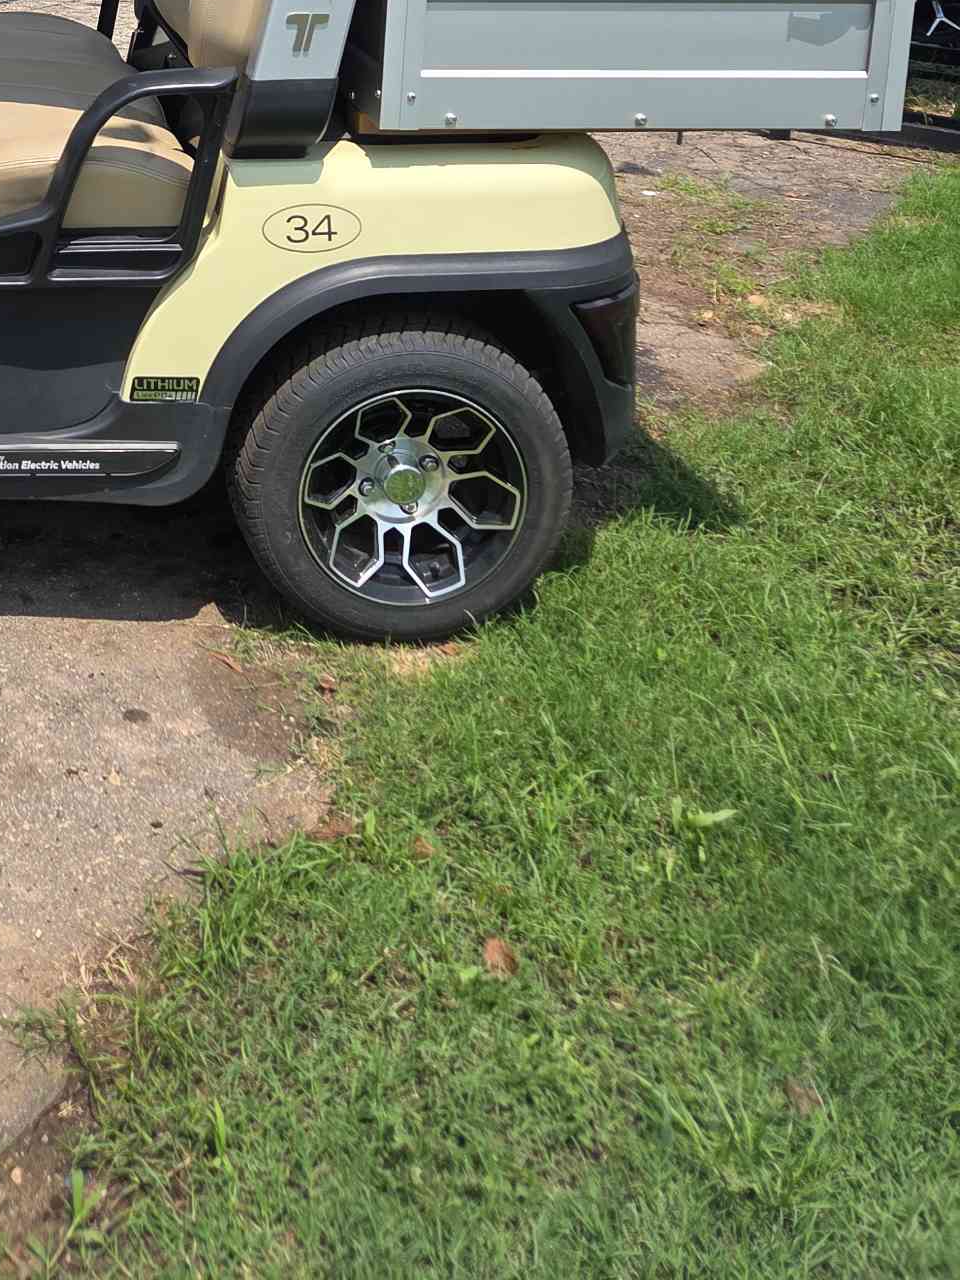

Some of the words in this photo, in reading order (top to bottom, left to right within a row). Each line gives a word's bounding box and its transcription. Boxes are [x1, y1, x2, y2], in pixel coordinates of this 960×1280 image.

[286, 214, 338, 243] 34
[134, 378, 197, 390] LITHIUM
[21, 460, 59, 470] Electric
[61, 460, 100, 470] Vehicles
